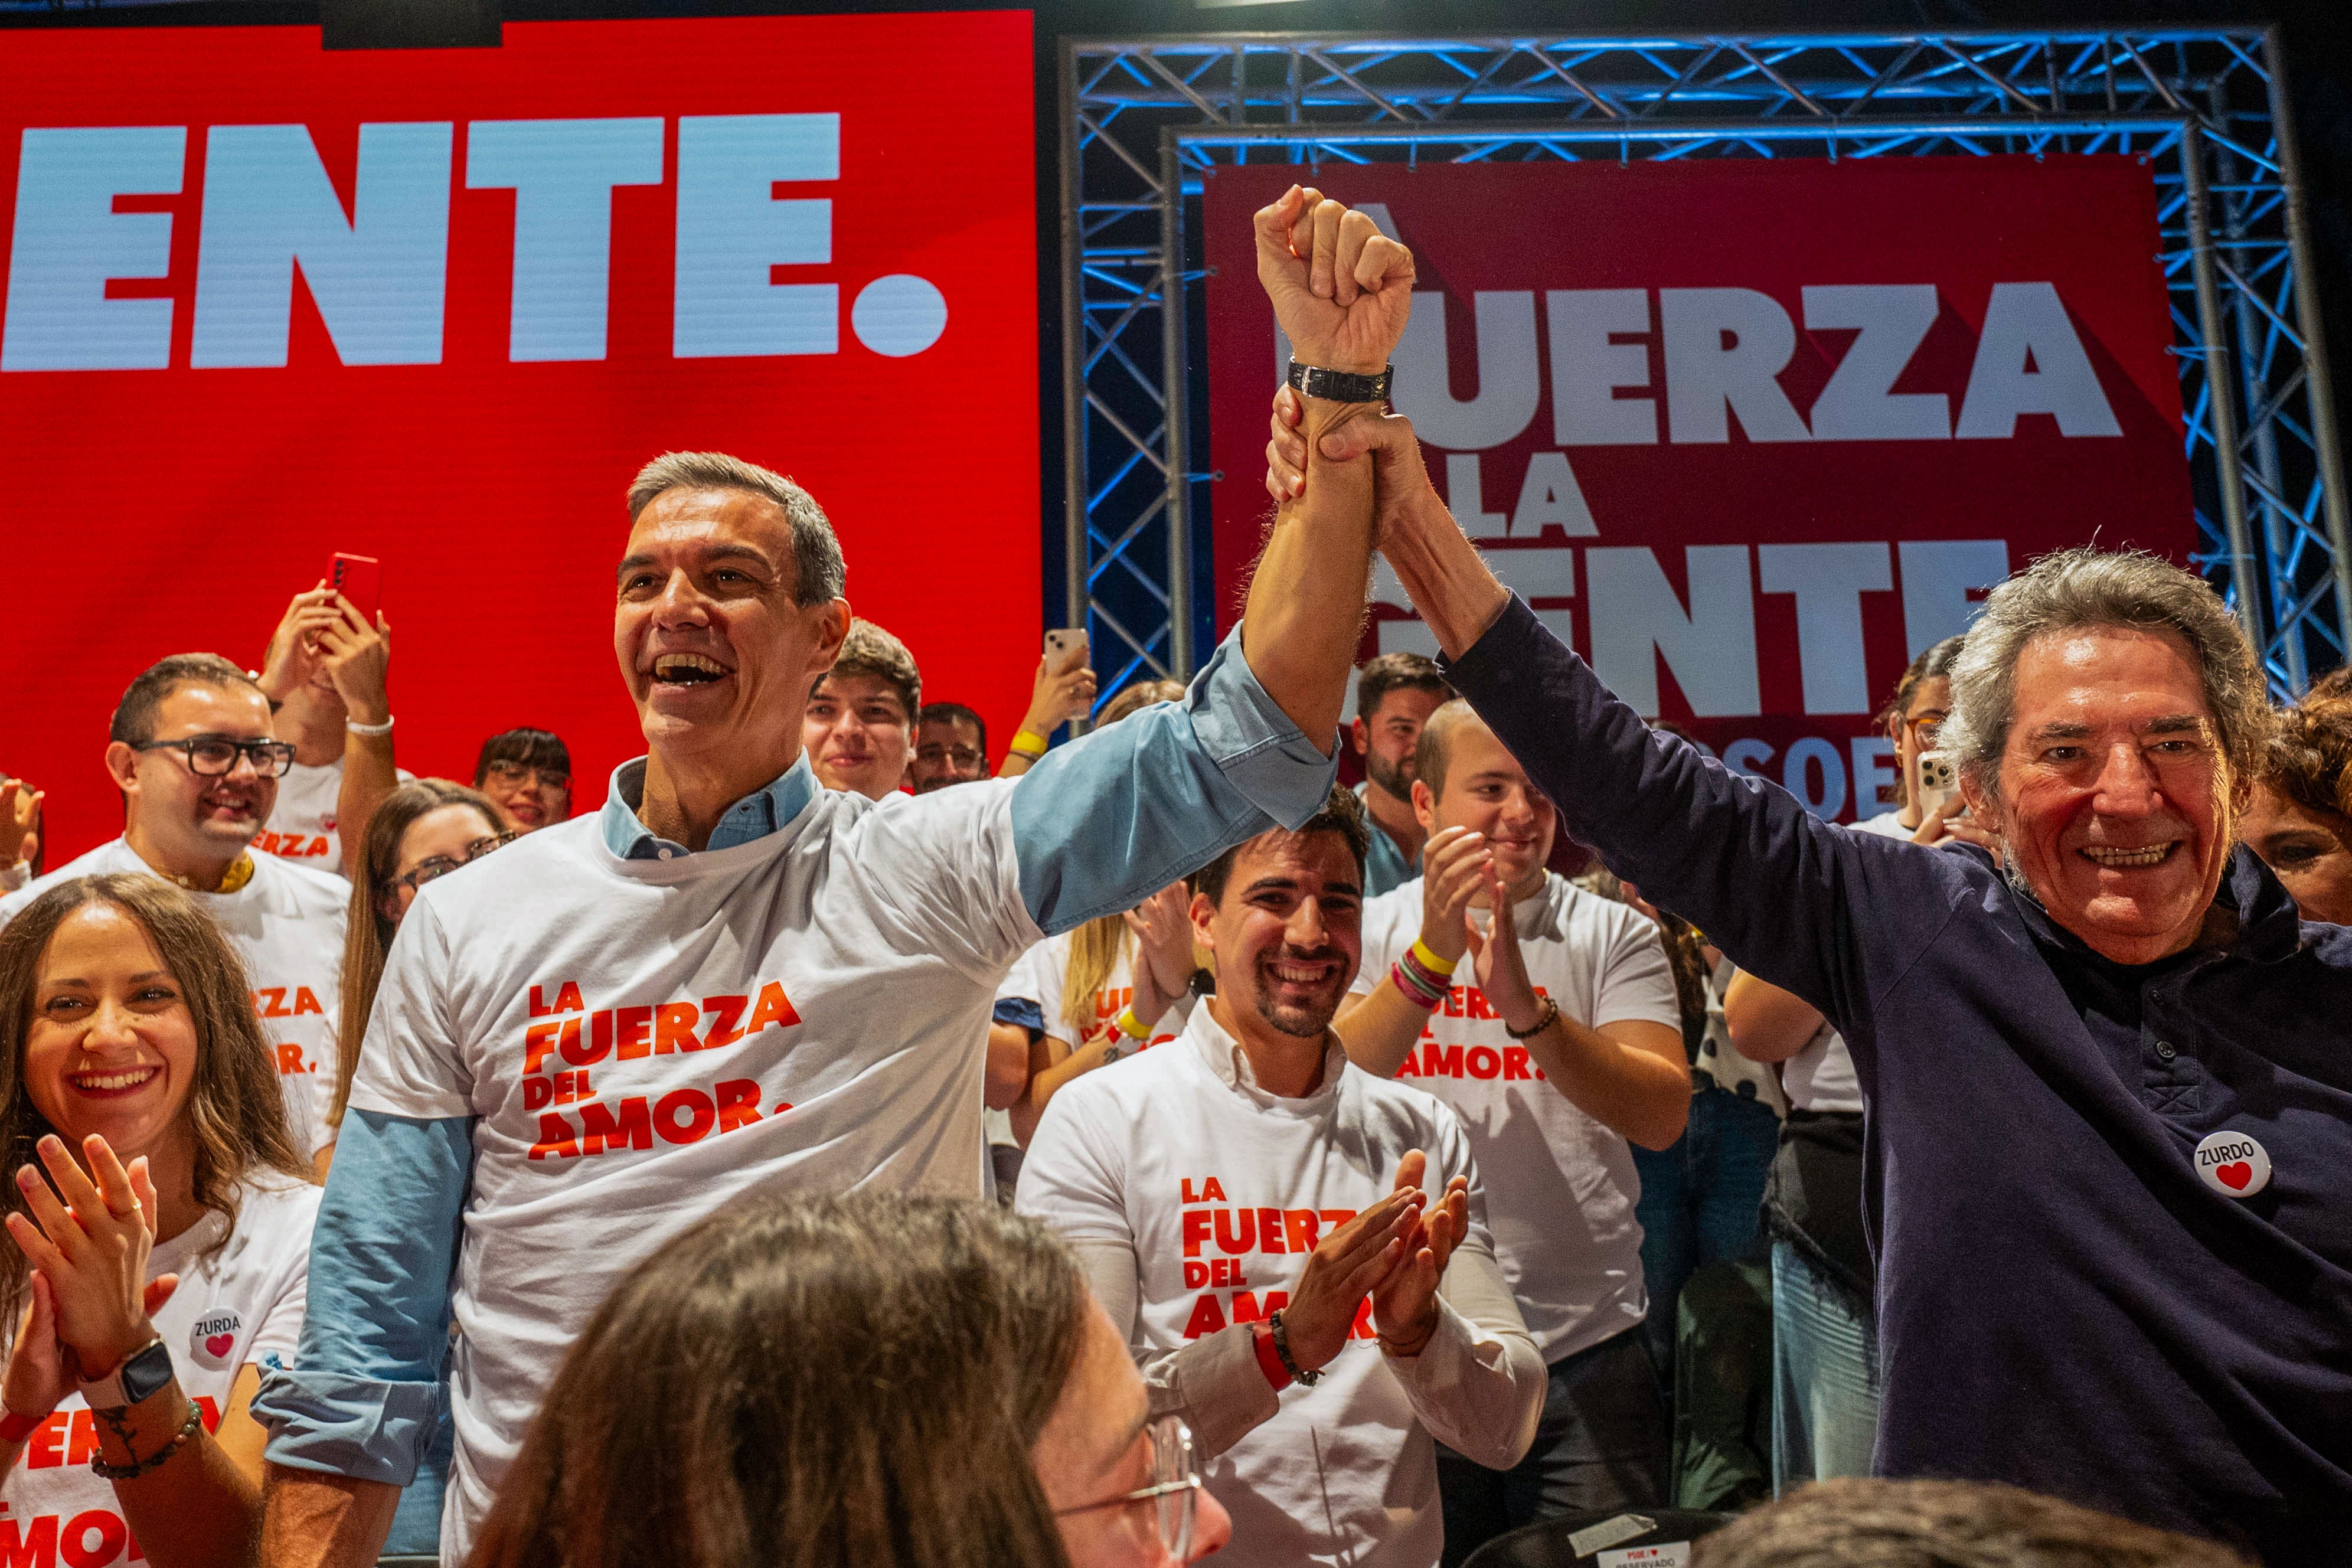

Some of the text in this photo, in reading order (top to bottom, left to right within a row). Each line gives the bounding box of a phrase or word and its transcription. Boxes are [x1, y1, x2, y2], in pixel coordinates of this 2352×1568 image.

[1, 112, 948, 372] ENTE.
[1274, 282, 2122, 449] UERZA
[1448, 452, 1599, 538] LA
[529, 981, 584, 1018] LA
[522, 981, 802, 1074] FUERZA
[522, 1070, 597, 1110] DEL
[528, 1079, 794, 1161] AMOR.
[2197, 1141, 2254, 1167] ZURDO
[1181, 1177, 1227, 1204] LA
[1183, 1258, 1247, 1289] DEL
[195, 1316, 241, 1337] ZURDA
